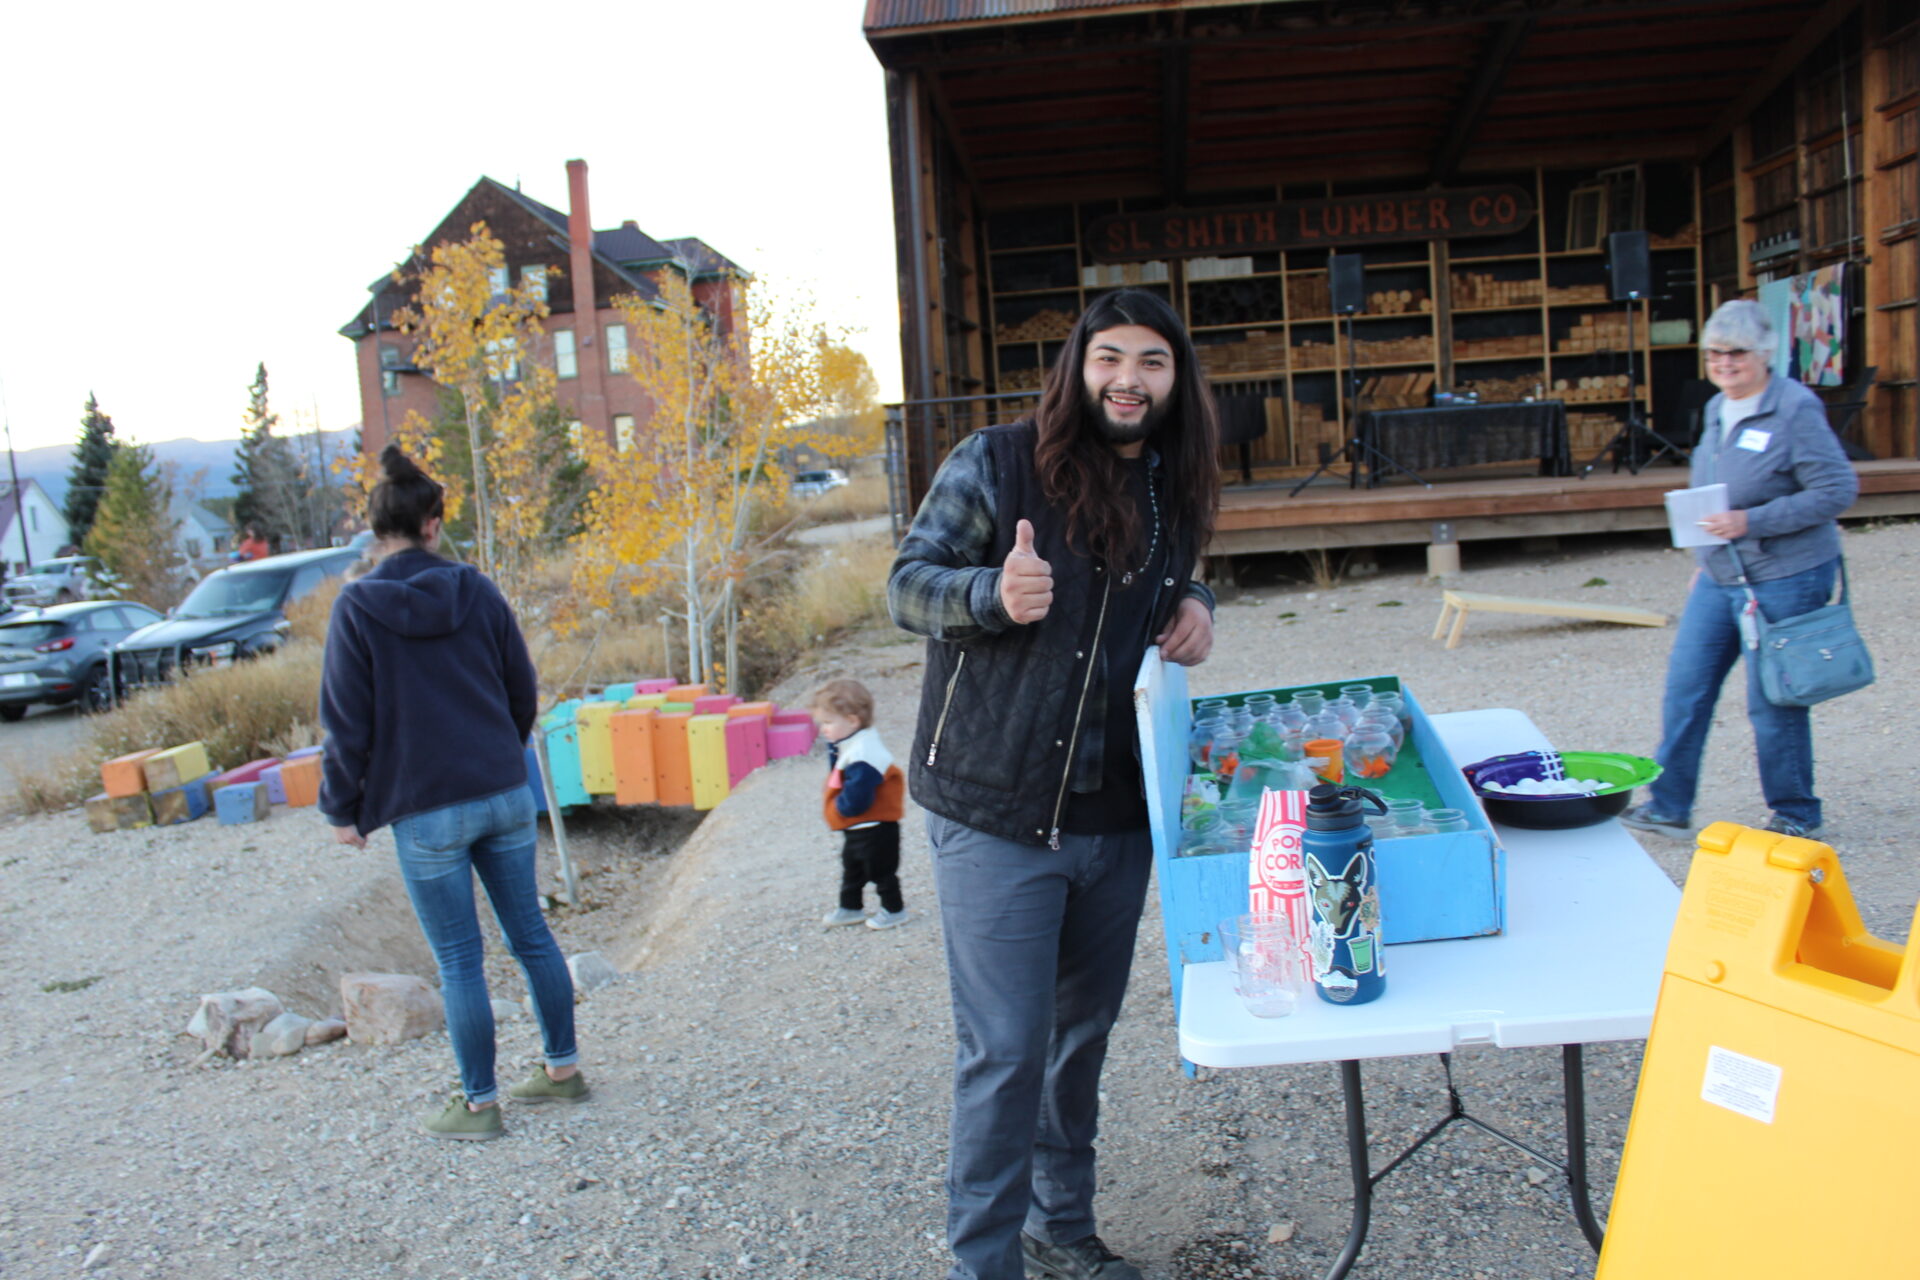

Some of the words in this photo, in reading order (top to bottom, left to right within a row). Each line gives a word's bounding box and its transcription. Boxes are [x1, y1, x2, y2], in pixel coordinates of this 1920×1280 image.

[1106, 223, 1151, 253] SL
[1164, 211, 1278, 249] SMITH
[1298, 199, 1451, 239] LUMBER
[1469, 193, 1517, 227] CO
[1265, 854, 1303, 870] COR
